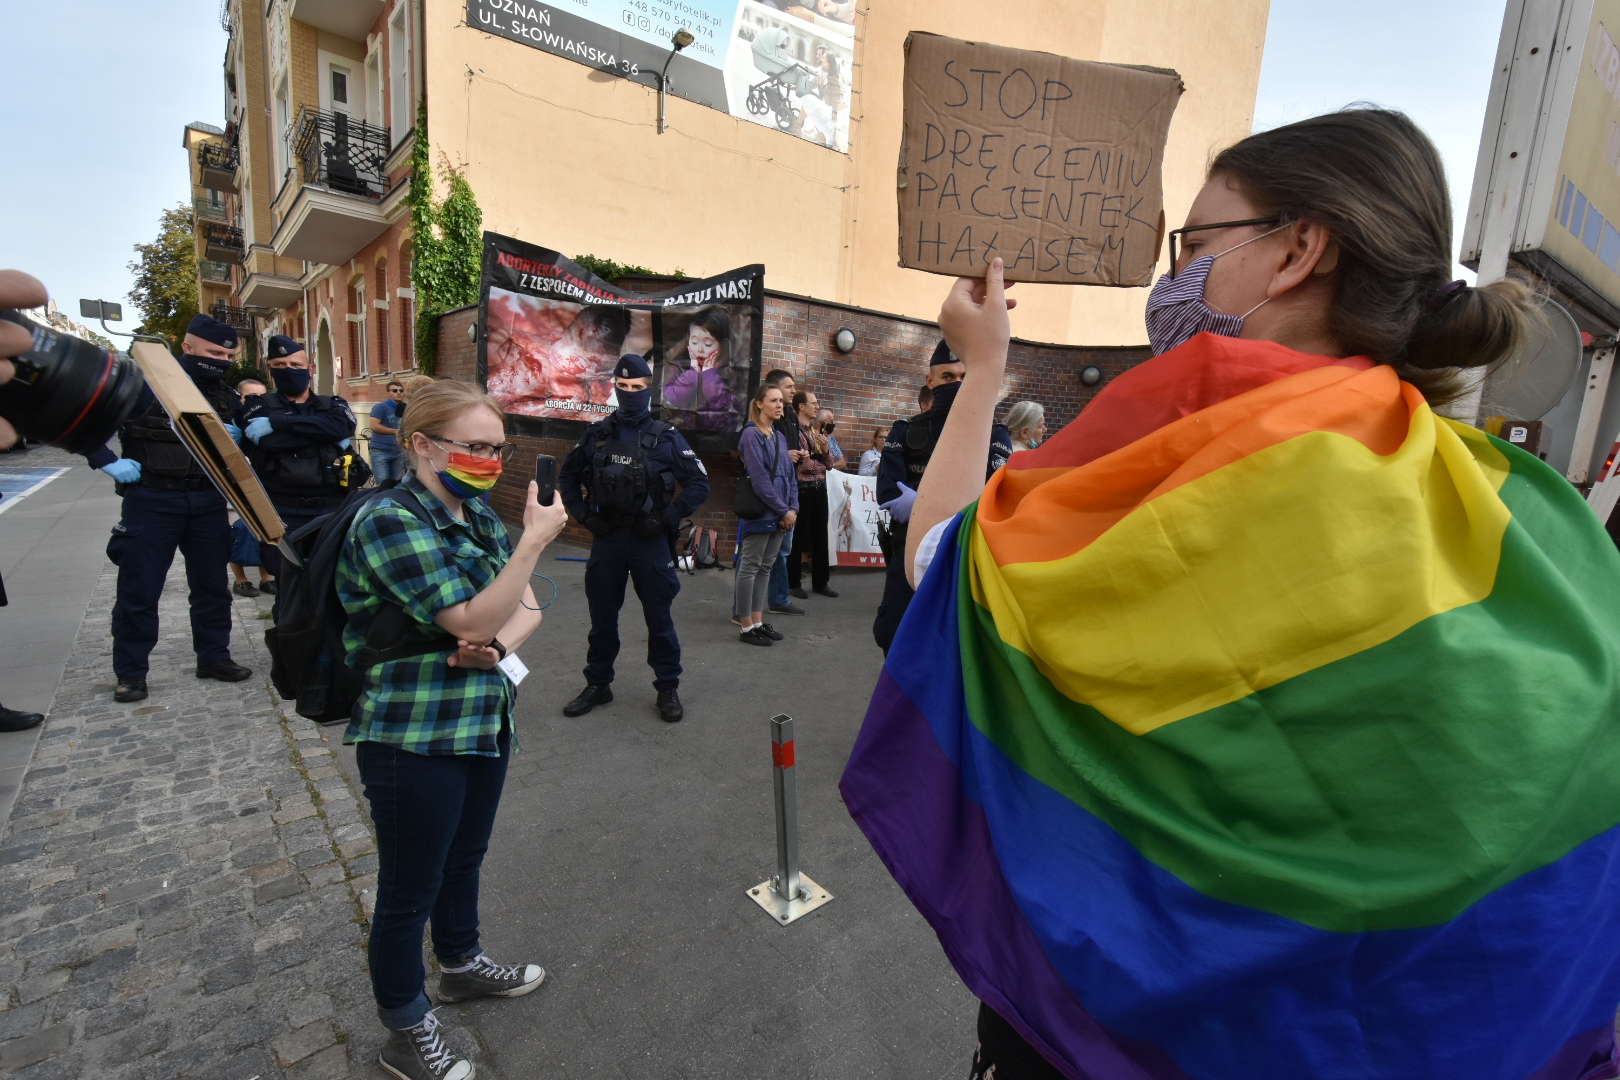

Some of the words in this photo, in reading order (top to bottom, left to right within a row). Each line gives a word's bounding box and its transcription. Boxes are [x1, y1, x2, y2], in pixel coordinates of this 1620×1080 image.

[479, 0, 551, 27] OZNAŃ
[652, 7, 671, 22] 570
[674, 15, 693, 30] 547
[696, 25, 713, 39] 474
[479, 9, 506, 30] UL.
[512, 20, 617, 69] SŁOWIAŃSKA
[622, 59, 639, 76] 36
[944, 60, 1073, 121] STOP
[497, 251, 563, 278] ABORTERZY
[520, 273, 528, 288] Z
[530, 275, 584, 298] ZESPOŁEM
[663, 287, 712, 307] RATUJ
[715, 279, 753, 300] NAS!
[544, 399, 575, 411] ABORCJA
[575, 403, 582, 412] W
[582, 403, 592, 412] 22
[611, 454, 632, 465] POLICJA
